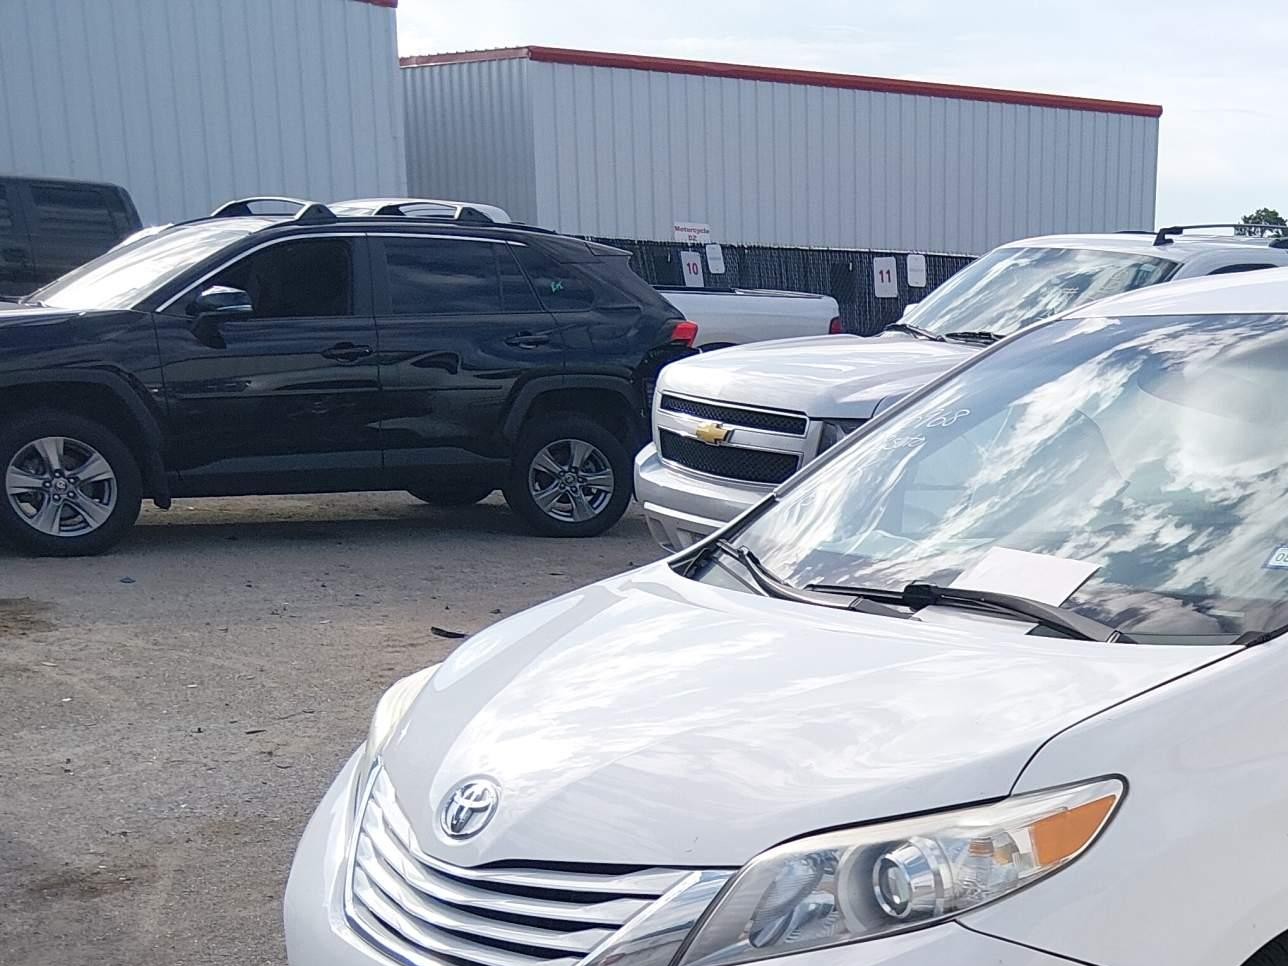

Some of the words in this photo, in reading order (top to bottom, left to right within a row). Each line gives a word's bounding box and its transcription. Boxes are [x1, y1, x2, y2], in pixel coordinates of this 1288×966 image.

[674, 226, 709, 234] Motorcycle
[687, 262, 698, 275] 10
[879, 269, 891, 283] 11
